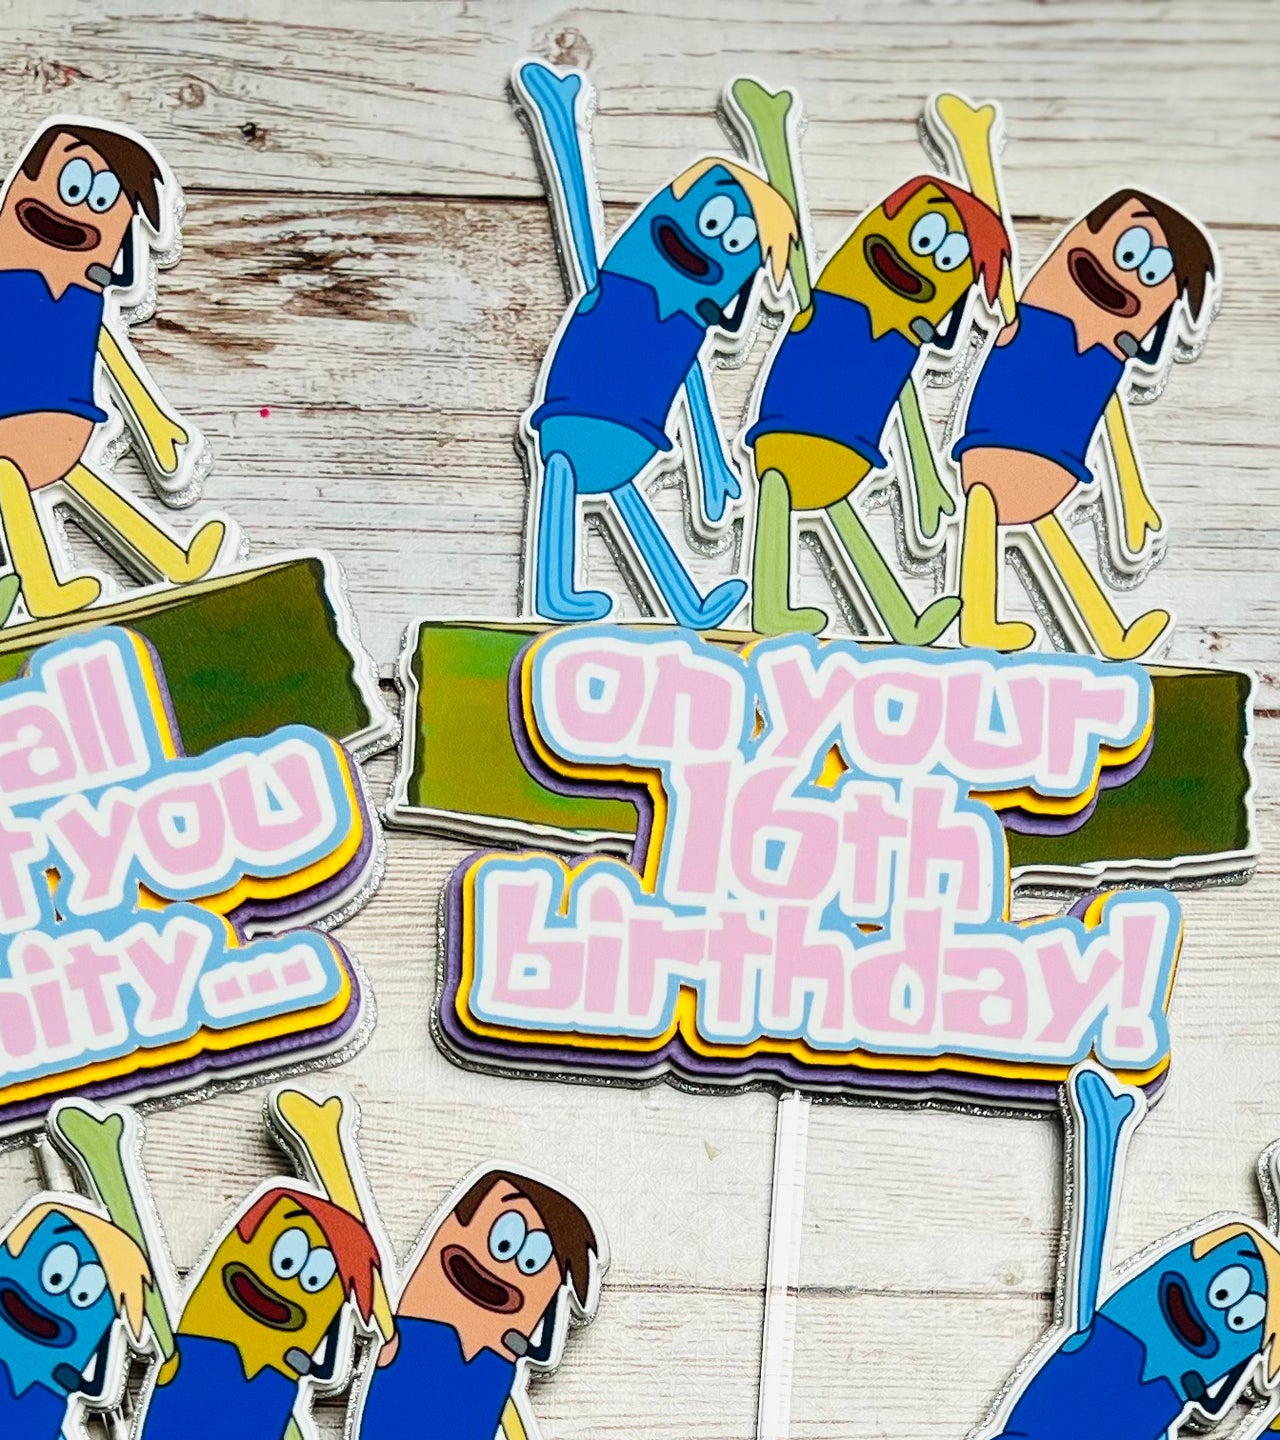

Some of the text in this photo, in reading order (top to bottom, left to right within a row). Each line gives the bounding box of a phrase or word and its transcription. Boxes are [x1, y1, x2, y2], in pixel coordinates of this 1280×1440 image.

[773, 660, 1126, 775] your
[58, 752, 323, 901] you
[678, 761, 980, 910] 16th
[494, 884, 1156, 1048] birthday!
